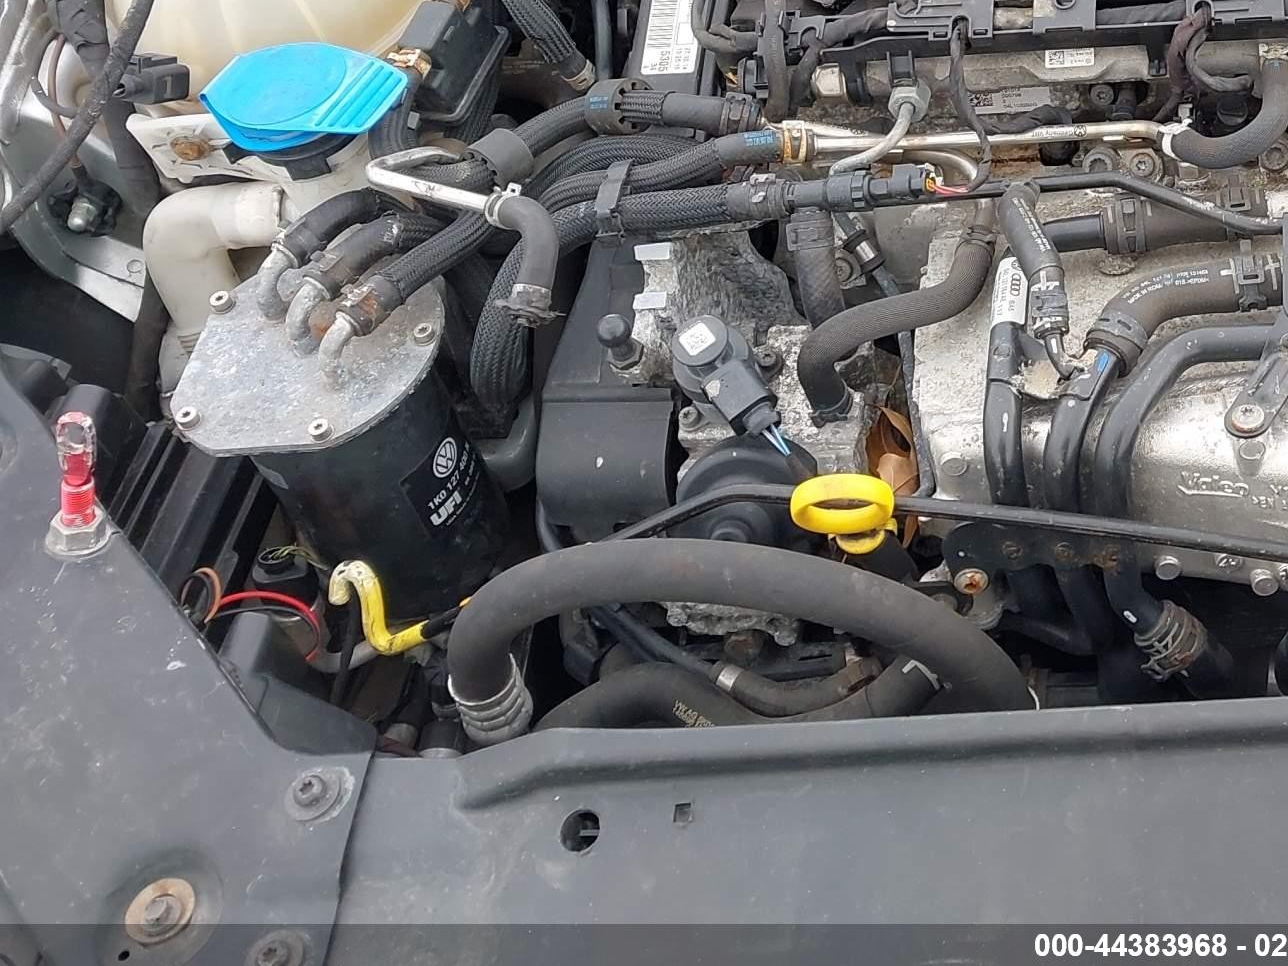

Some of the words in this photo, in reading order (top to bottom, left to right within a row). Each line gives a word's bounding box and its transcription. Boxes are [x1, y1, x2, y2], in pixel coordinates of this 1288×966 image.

[658, 50, 671, 73] 5305
[447, 470, 460, 491] 127
[429, 490, 463, 526] UFI
